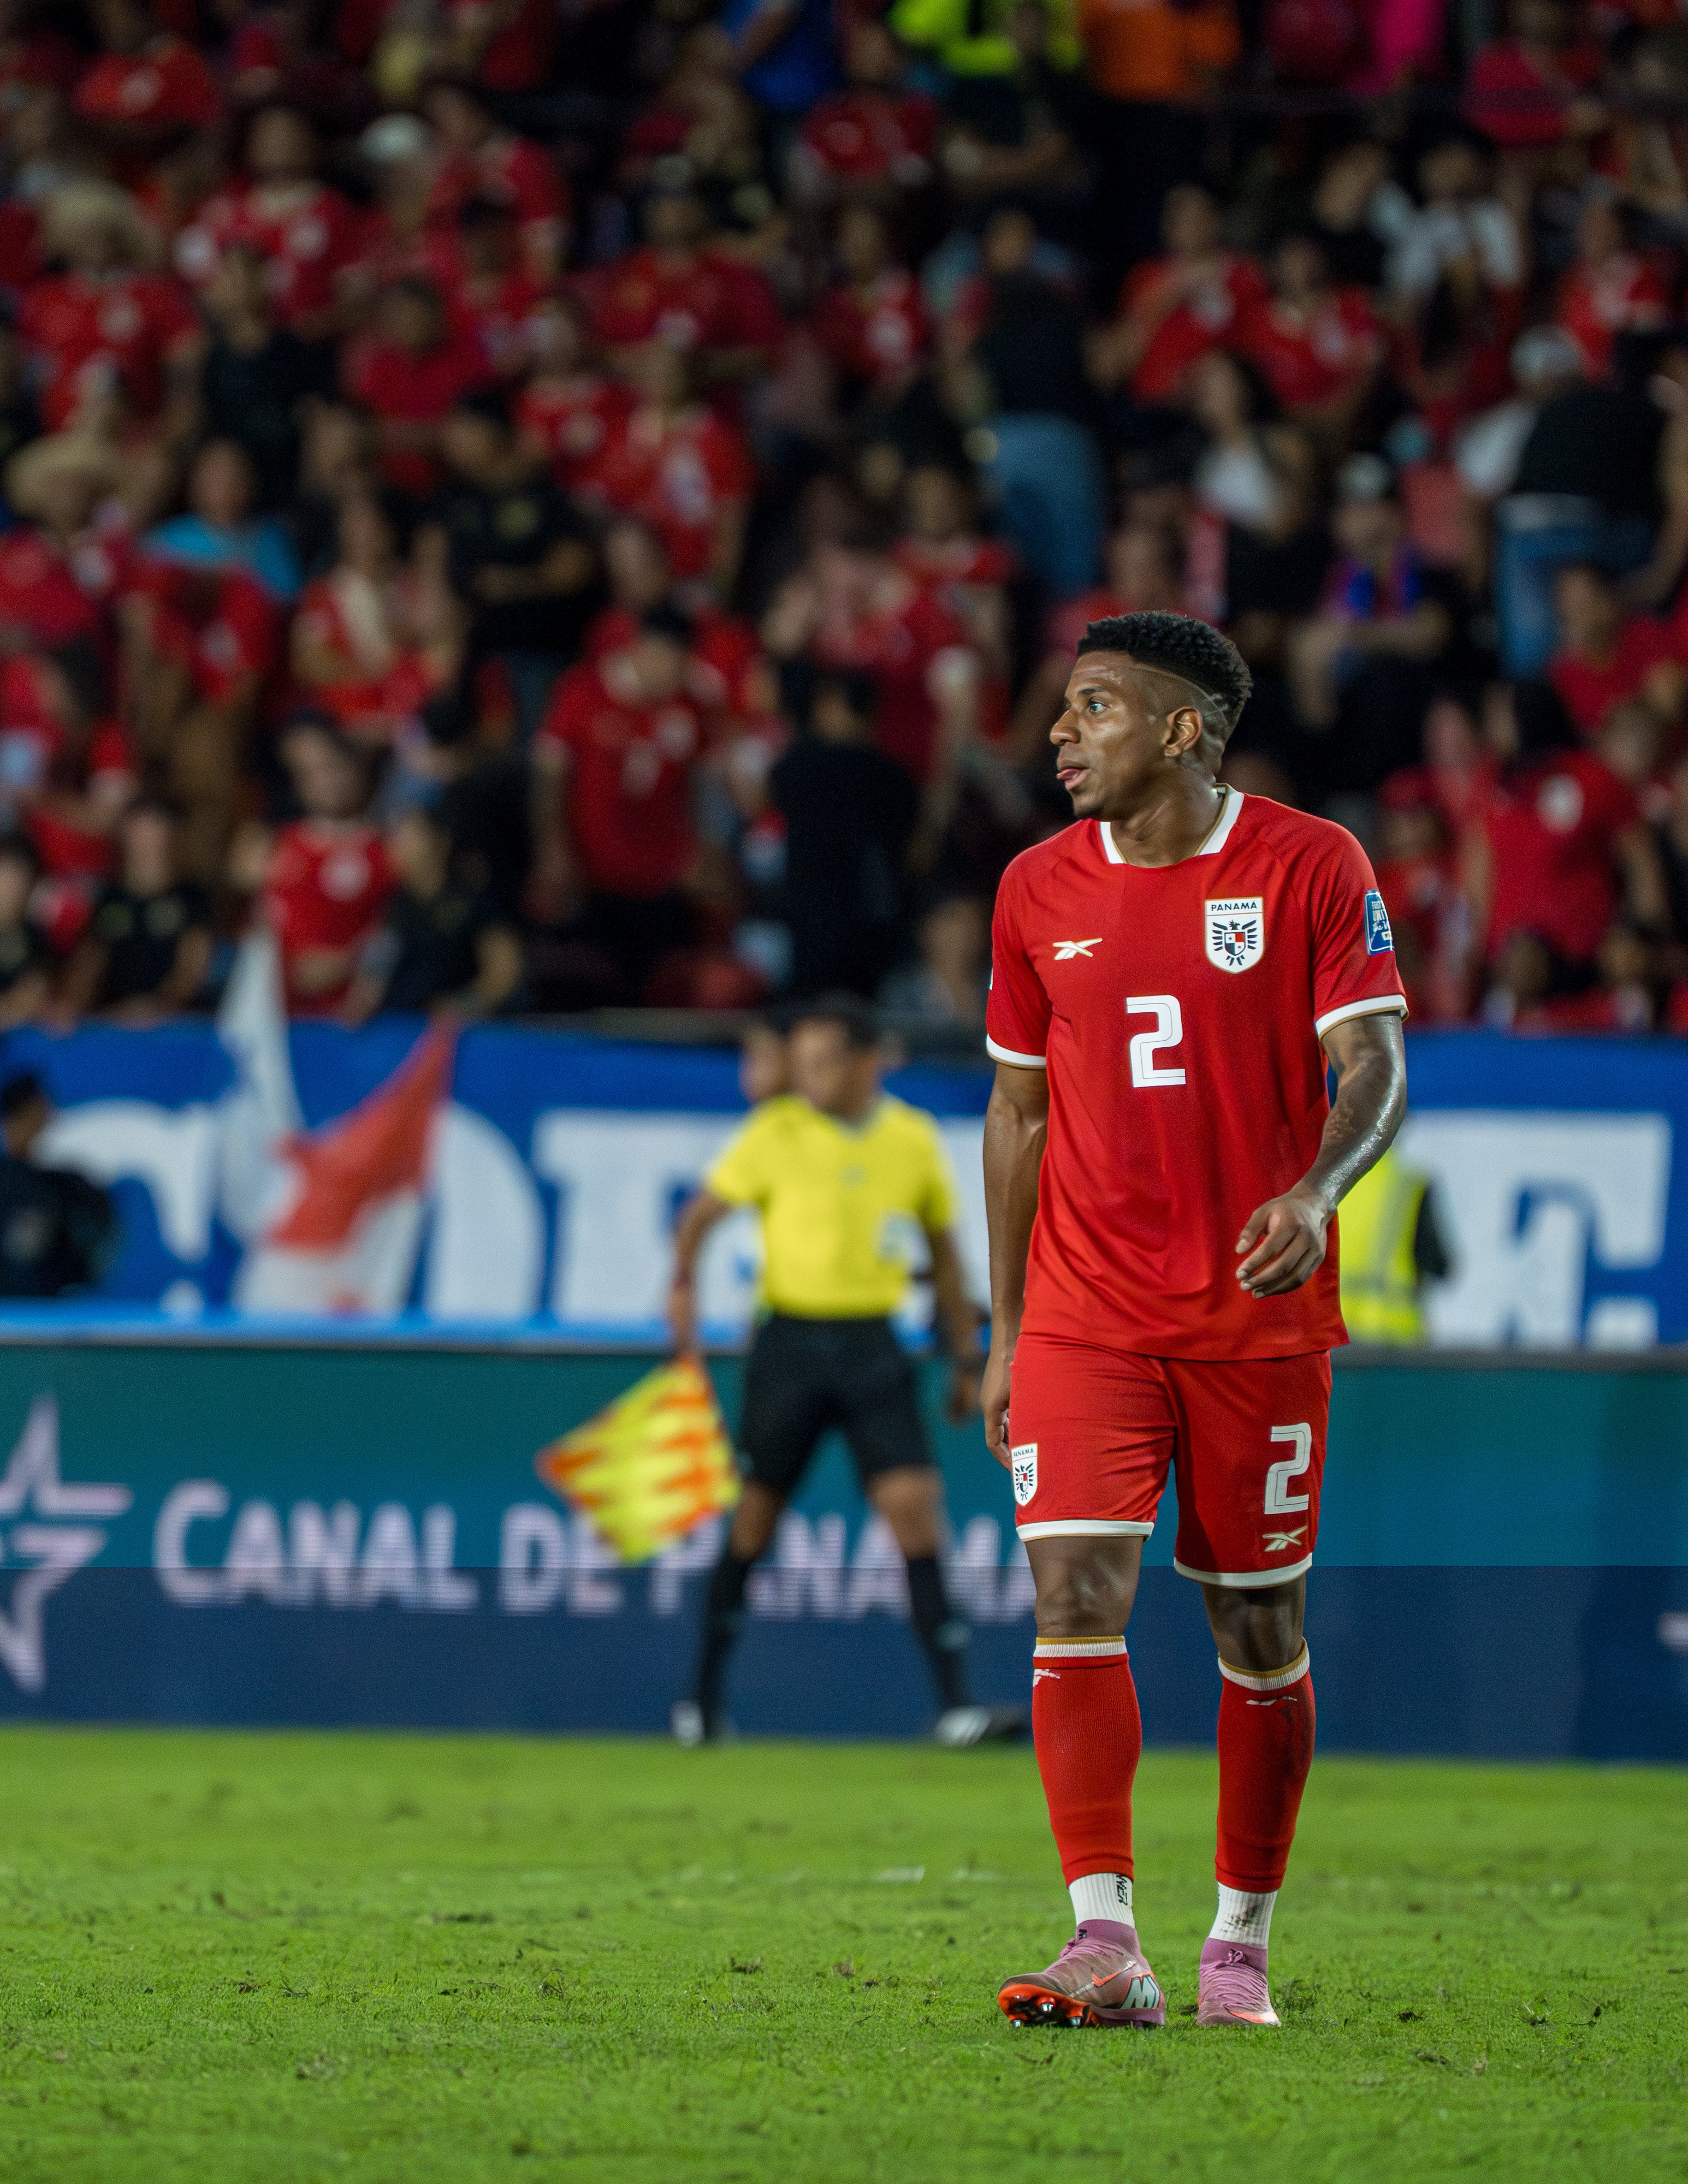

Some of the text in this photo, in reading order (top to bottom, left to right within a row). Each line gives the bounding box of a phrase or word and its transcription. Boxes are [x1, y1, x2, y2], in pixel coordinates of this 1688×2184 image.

[1126, 994, 1186, 1088] 2
[1264, 1422, 1312, 1515] 2
[152, 1477, 482, 1612] CANAL
[498, 1500, 623, 1617] DE
